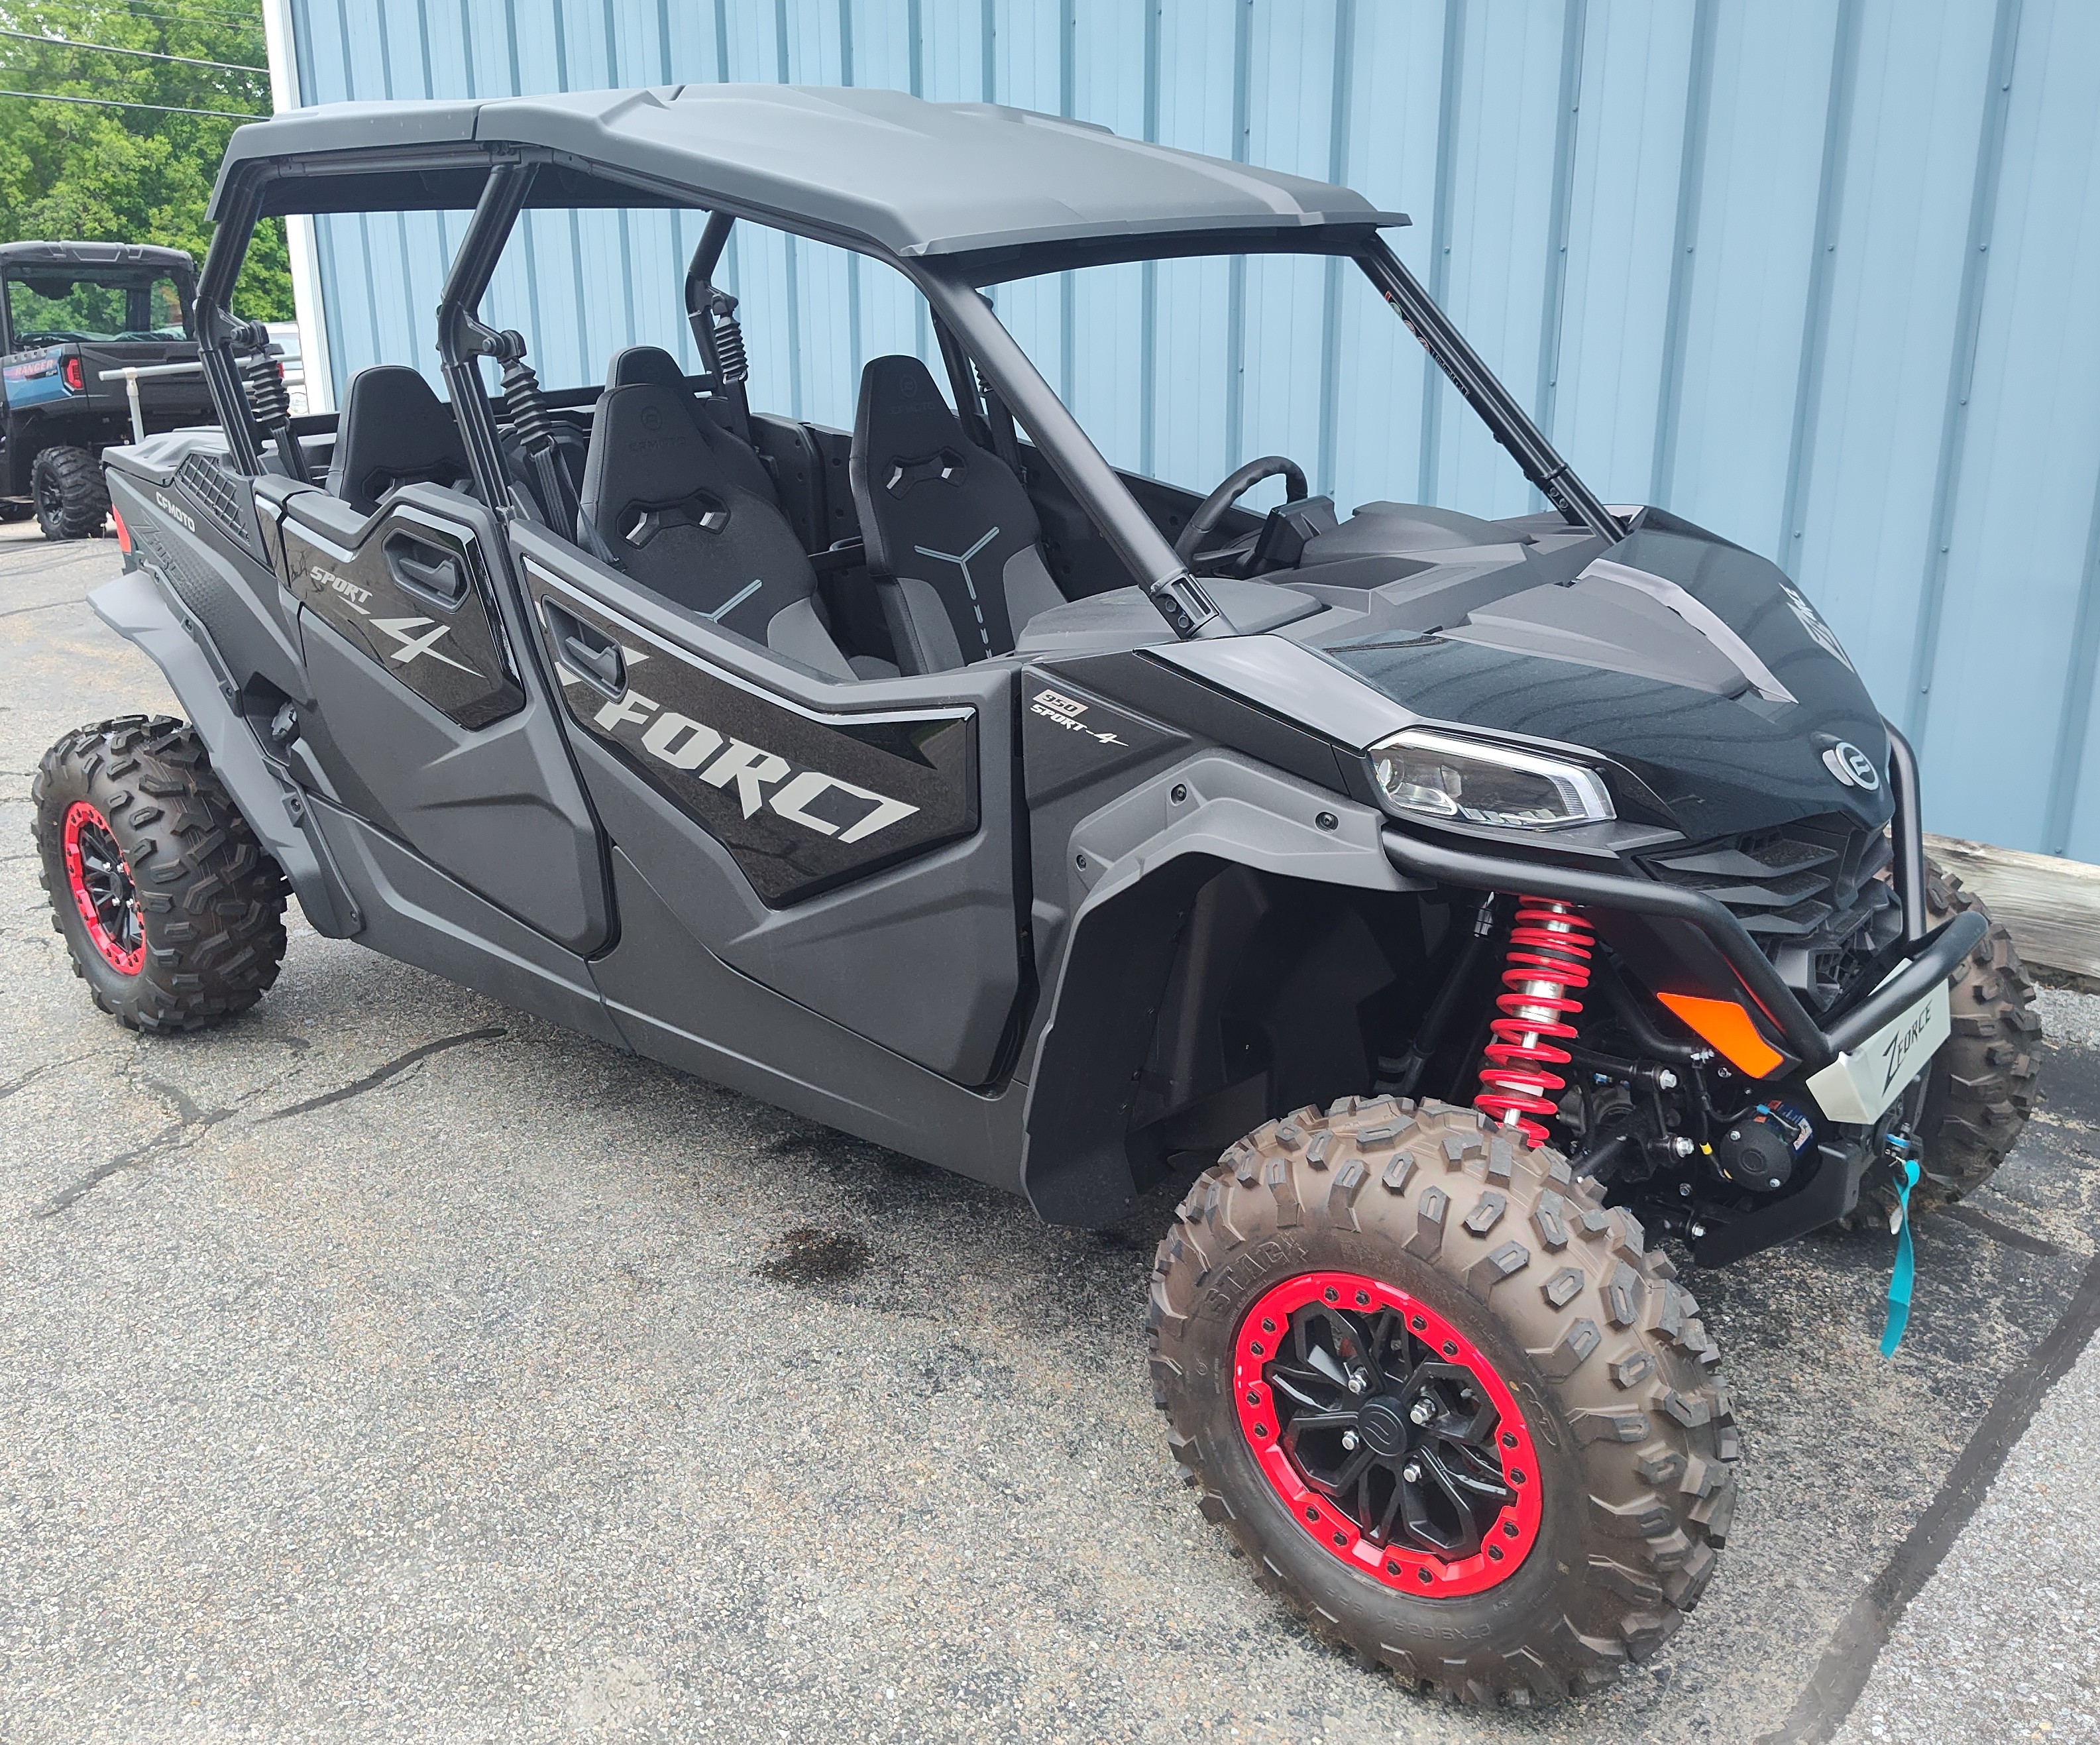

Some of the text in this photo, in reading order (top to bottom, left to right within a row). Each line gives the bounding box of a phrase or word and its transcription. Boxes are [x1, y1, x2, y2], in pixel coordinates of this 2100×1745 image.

[15, 359, 54, 376] RANGER
[156, 491, 195, 533] CFMOTO
[310, 565, 372, 604] SPORT
[368, 617, 487, 679] 4
[1042, 693, 1079, 712] 950
[1882, 999, 1932, 1098] ZFORCE
